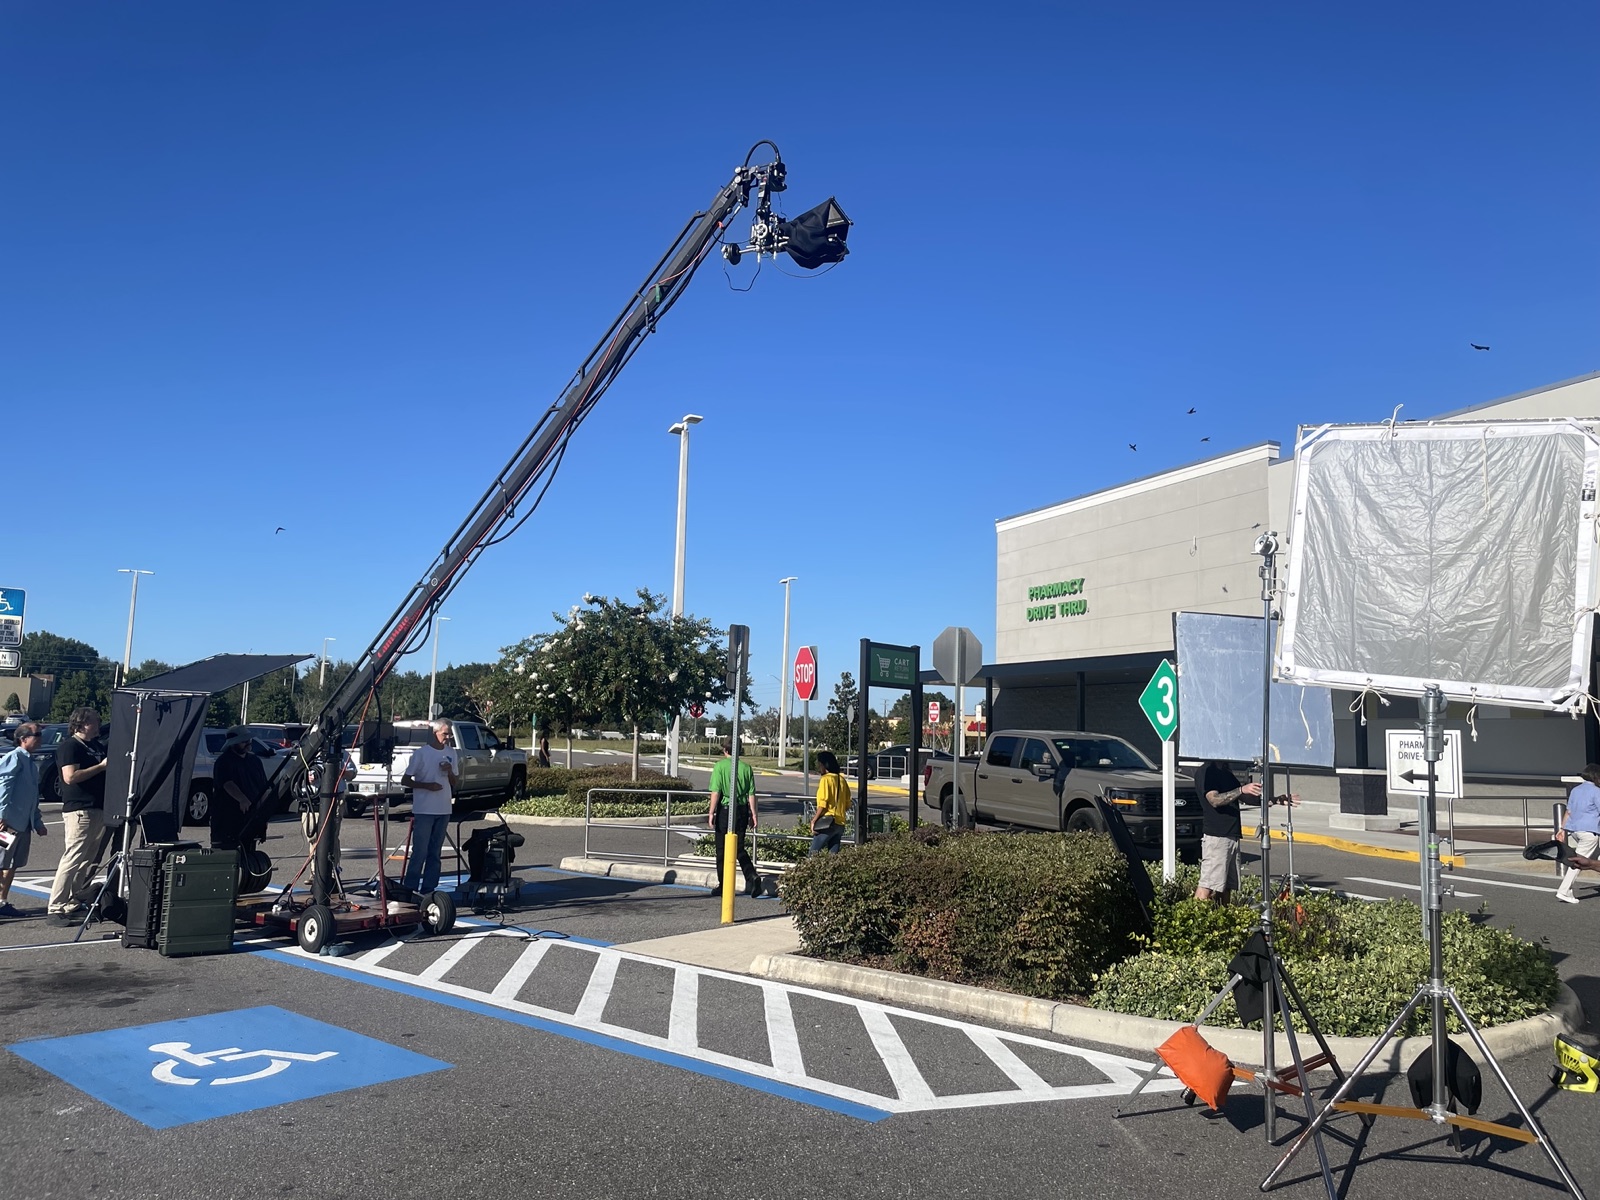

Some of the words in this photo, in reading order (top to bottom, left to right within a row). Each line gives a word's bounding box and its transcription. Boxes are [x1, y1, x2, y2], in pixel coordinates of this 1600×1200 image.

[1028, 578, 1085, 600] PHARMACY
[1027, 604, 1056, 621] DRIVE
[1058, 599, 1087, 617] THRU
[894, 658, 910, 666] CART
[795, 663, 813, 683] STOP
[1156, 676, 1174, 726] 3
[1399, 740, 1425, 749] PHARM
